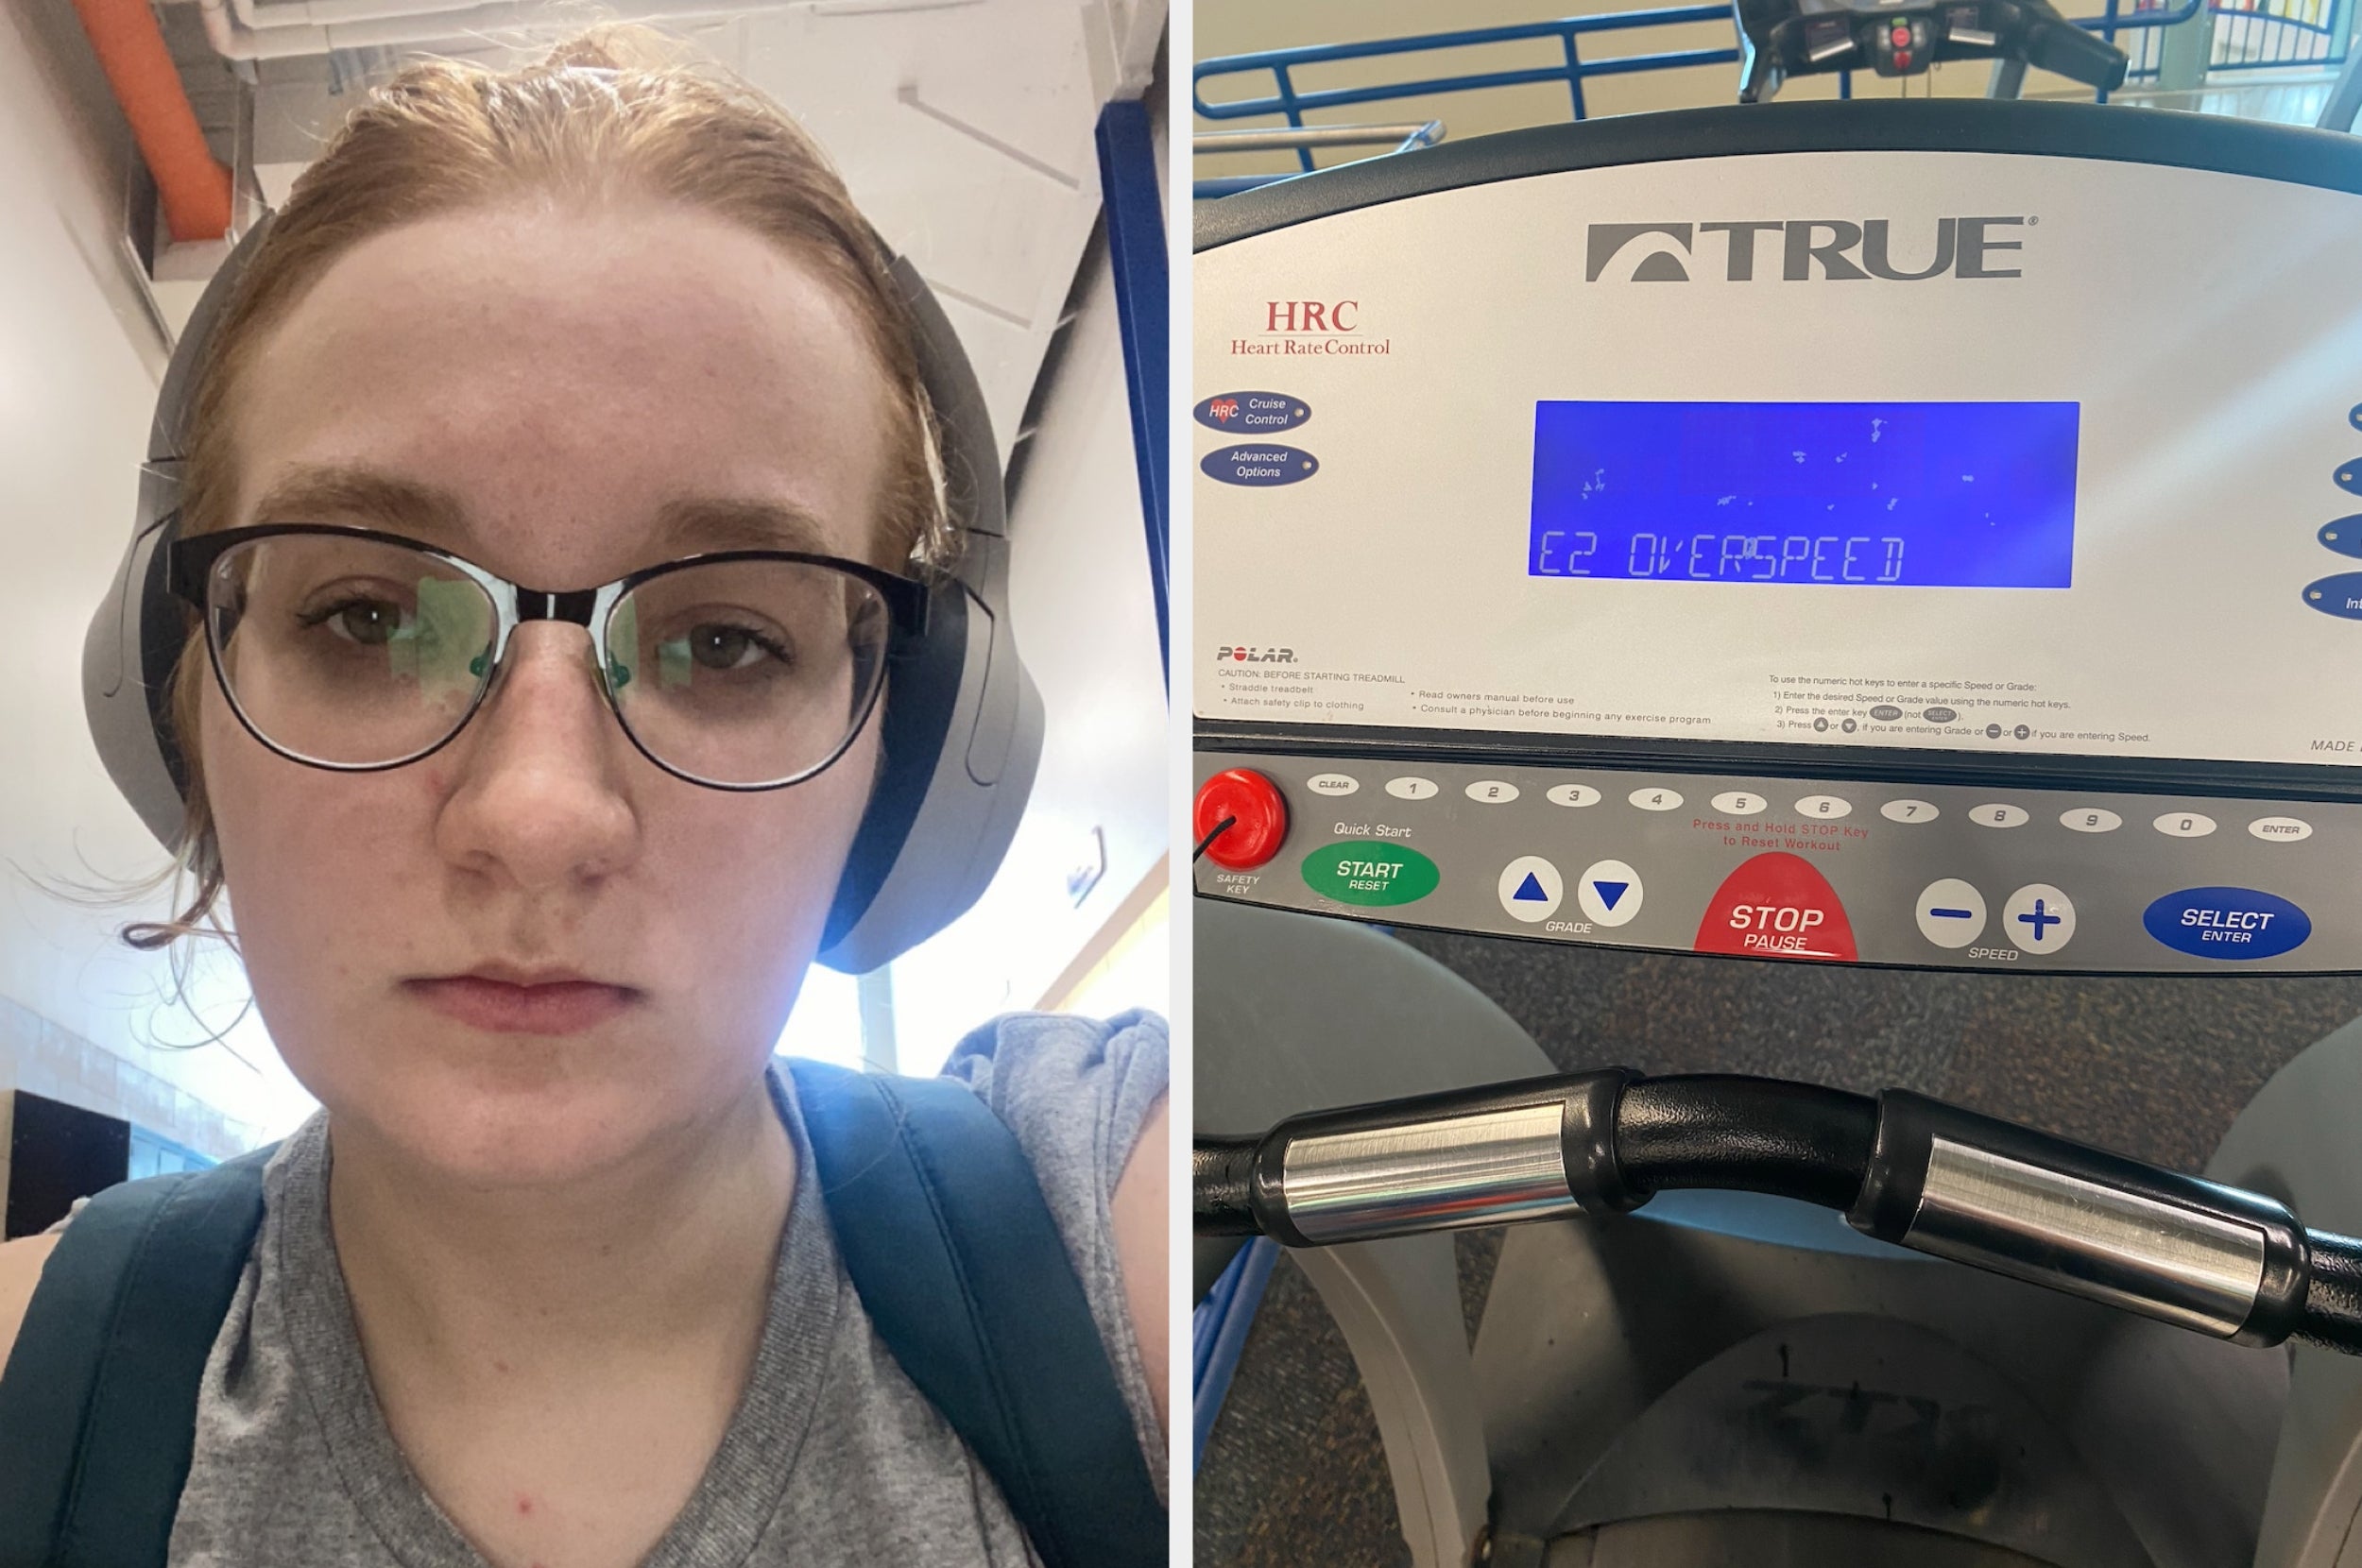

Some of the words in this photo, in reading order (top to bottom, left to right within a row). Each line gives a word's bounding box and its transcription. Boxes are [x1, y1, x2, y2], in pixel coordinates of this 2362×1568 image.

[1265, 300, 1359, 332] HRC
[1231, 339, 1279, 355] Heart
[1284, 339, 1323, 355] Rate
[1325, 339, 1390, 355] Control
[1209, 405, 1239, 418] HRC
[1249, 398, 1286, 409] Cruise
[1245, 414, 1288, 425] Control
[1231, 452, 1288, 462] Advanced
[1236, 467, 1281, 479] Options
[1539, 531, 1598, 574] E2
[1628, 533, 1905, 582] OVERSPEED
[1218, 669, 1261, 679] CAUTION:
[1263, 671, 1301, 680] BEFORE
[1303, 672, 1350, 682] STARTING
[1353, 673, 1405, 684] TREADMILL
[1769, 674, 1779, 683] To
[1798, 675, 1811, 684] the
[1813, 676, 1847, 686] numeric
[1849, 677, 1862, 687] hot
[1865, 678, 1885, 689] keys
[1928, 680, 1962, 690] specific
[1964, 681, 1993, 691] Speed
[2007, 682, 2037, 691] Grade:
[1229, 683, 1268, 692] Straddle
[1271, 685, 1313, 694] treadbelt
[1419, 690, 1444, 700] Read
[1483, 693, 1519, 703] manual
[1523, 694, 1553, 704] before
[1773, 691, 1781, 701] 1)
[1783, 691, 1806, 701] Enter
[1807, 692, 1821, 701] the
[1823, 692, 1854, 703] desired
[1857, 694, 1884, 705] Speed
[1896, 695, 1924, 705] Grade
[1926, 696, 1948, 705] value
[1950, 697, 1975, 707] using
[1977, 698, 1991, 707] the
[1993, 699, 2028, 707] numeric
[2031, 700, 2045, 708] hot
[2047, 701, 2071, 710] keys.
[1231, 697, 1260, 707] Attach
[1263, 698, 1291, 708] safety
[1293, 699, 1311, 709] clip
[1326, 700, 1364, 711] clothing
[1421, 705, 1458, 714] Consult
[1469, 707, 1515, 718] physician
[1518, 708, 1549, 718] before
[1552, 710, 1601, 722] beginning
[1604, 713, 1622, 723] any
[1625, 713, 1666, 723] exercise
[1669, 716, 1711, 725] program
[1774, 706, 1783, 715] 2)
[1786, 707, 1809, 715] Press
[1812, 707, 1825, 716] the
[1827, 708, 1850, 717] enter
[1852, 708, 1867, 719] key
[1904, 709, 1921, 719] (not
[1776, 720, 1785, 729] 3)
[1789, 721, 1812, 729] Press
[1862, 723, 1869, 732] if
[1870, 724, 1887, 734] you
[1906, 725, 1942, 736] entering
[1944, 726, 1972, 735] Grade
[2031, 729, 2037, 738] if
[2040, 731, 2057, 741] you
[2077, 732, 2115, 742] entering
[2117, 732, 2150, 743] Speed.
[2311, 740, 2355, 752] MADE
[1319, 780, 1349, 790] CLEAR
[1409, 782, 1418, 794] 1
[1486, 787, 1499, 798] 2
[1568, 790, 1581, 802] 3
[1651, 793, 1663, 806] 4
[1736, 797, 1747, 809] 5
[1819, 801, 1830, 813] 6
[1906, 806, 1918, 818] 7
[1994, 810, 2006, 822] 8
[2085, 814, 2097, 827] 9
[1333, 822, 1371, 836] Quick
[1376, 824, 1412, 838] Start
[1693, 818, 1731, 831] Press
[1735, 821, 1759, 832] and
[1765, 823, 1795, 834] Hold
[1802, 825, 1839, 836] STOP
[1844, 827, 1869, 840] Key
[2180, 819, 2193, 831] 0
[2263, 824, 2302, 835] ENTER
[1723, 835, 1736, 845] to
[1741, 836, 1779, 848] Reset
[1785, 838, 1841, 851] Workout
[1337, 861, 1404, 878] START
[1216, 874, 1259, 885] SAFETY
[1348, 879, 1390, 891] RESET
[1226, 884, 1250, 895] KEY
[1729, 904, 1824, 932] STOP
[2181, 908, 2275, 930] SELECT
[1546, 921, 1593, 934] GRADE
[1743, 933, 1807, 950] PAUSE
[2201, 930, 2252, 944] ENTER
[1968, 947, 2019, 962] SPEED
